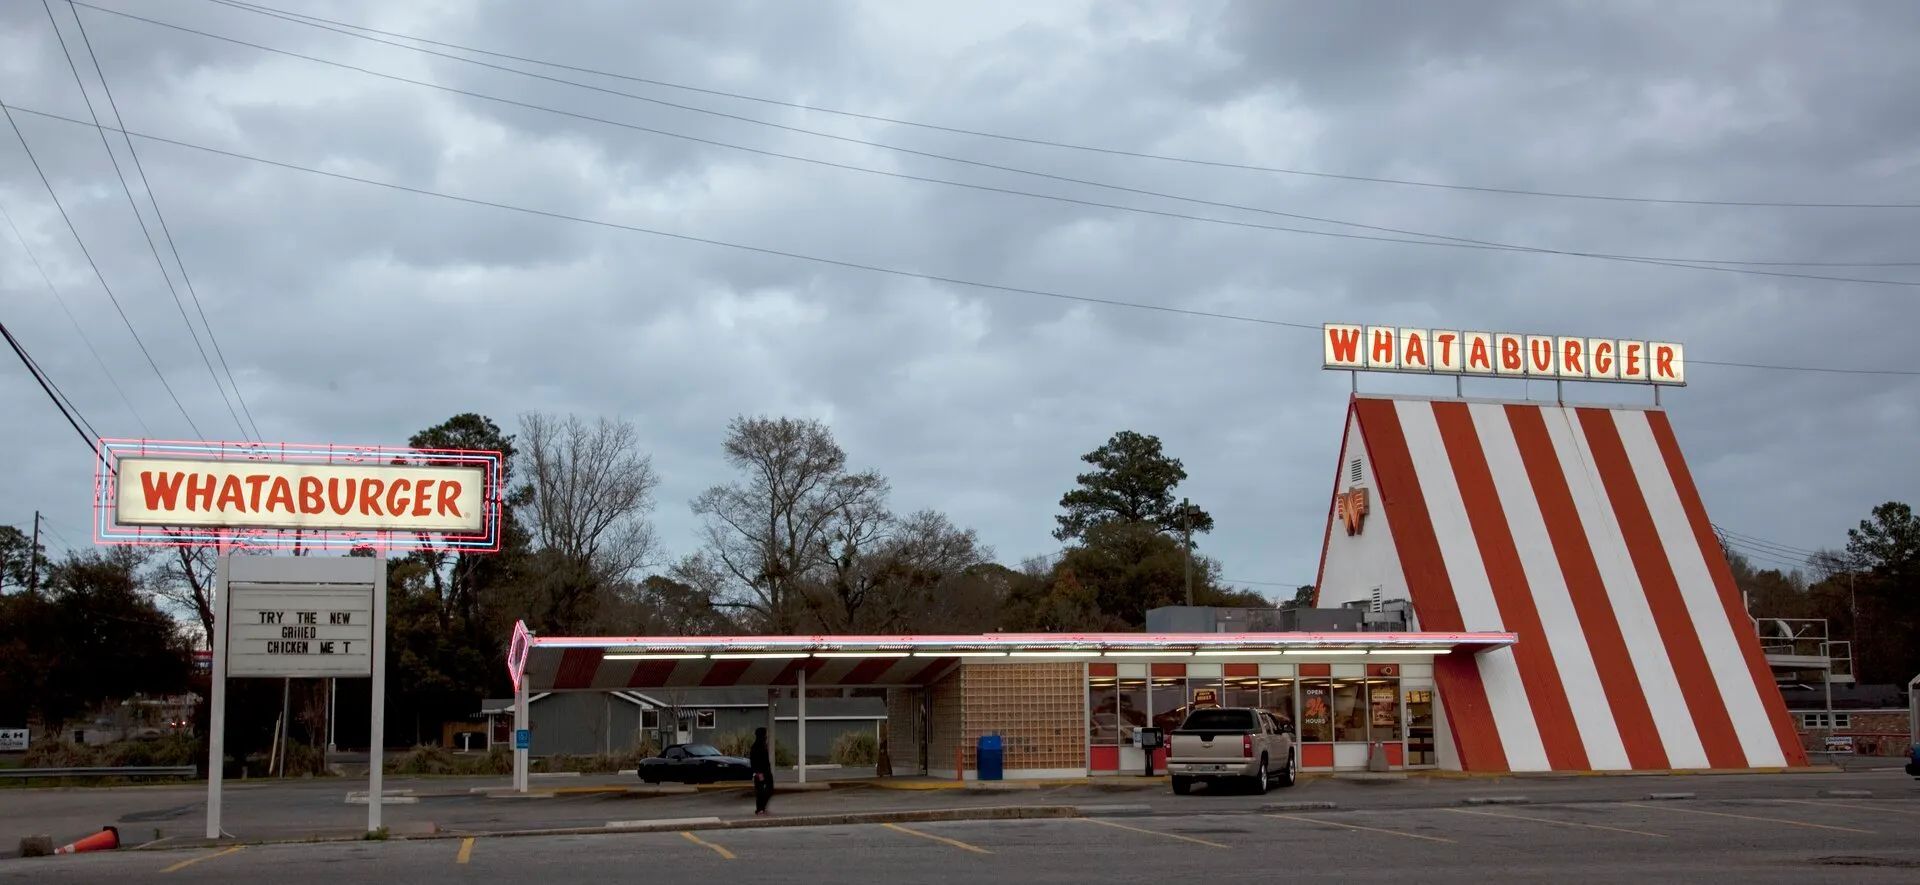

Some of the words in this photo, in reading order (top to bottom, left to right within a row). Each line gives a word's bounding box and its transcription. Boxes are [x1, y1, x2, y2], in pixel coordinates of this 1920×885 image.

[1329, 328, 1675, 378] WHATABURGER
[140, 471, 462, 518] WHATABURGER
[259, 612, 284, 624] TRY
[296, 612, 317, 624] THE
[330, 612, 351, 625] NEW
[267, 641, 308, 654] CHICKEN
[1304, 697, 1326, 717] 24
